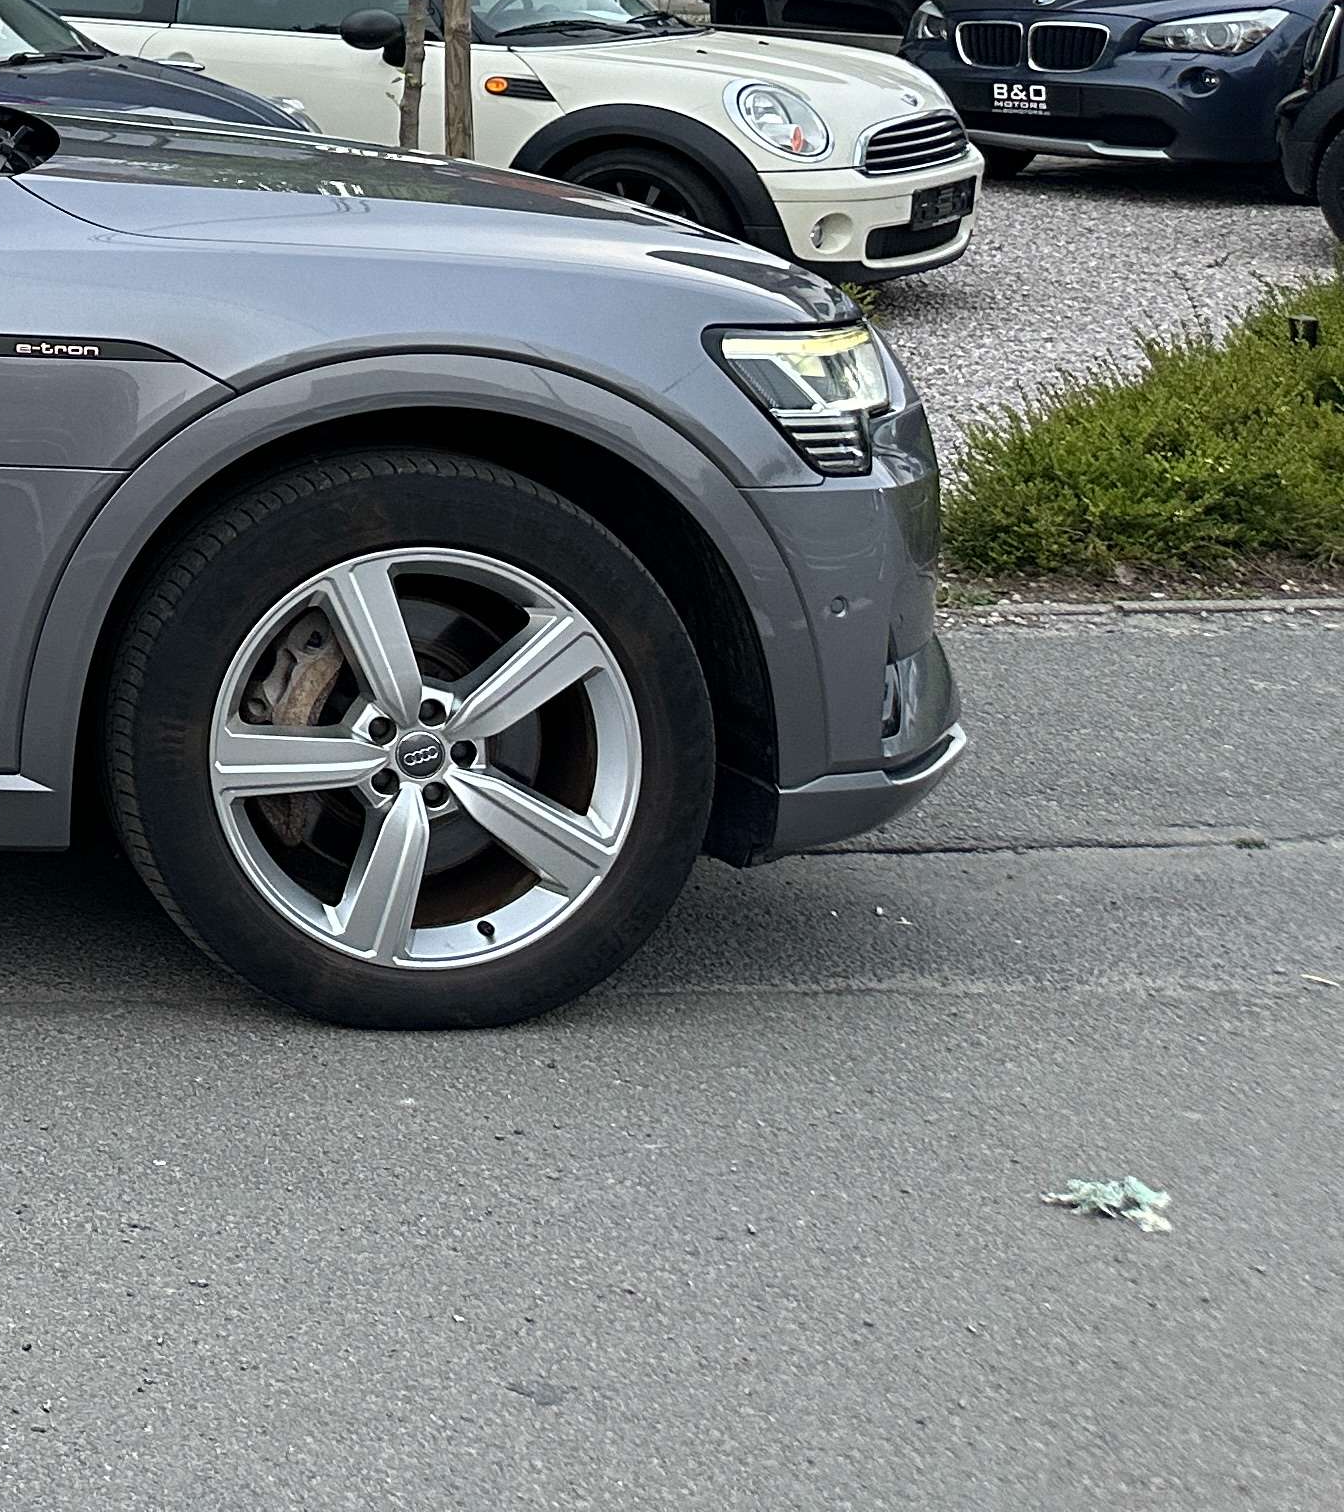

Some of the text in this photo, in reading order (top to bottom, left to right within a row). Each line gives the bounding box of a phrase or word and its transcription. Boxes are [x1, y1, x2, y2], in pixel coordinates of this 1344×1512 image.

[993, 83, 1046, 101] B&O
[993, 100, 1048, 110] MOTORS
[15, 342, 100, 357] e-tron
